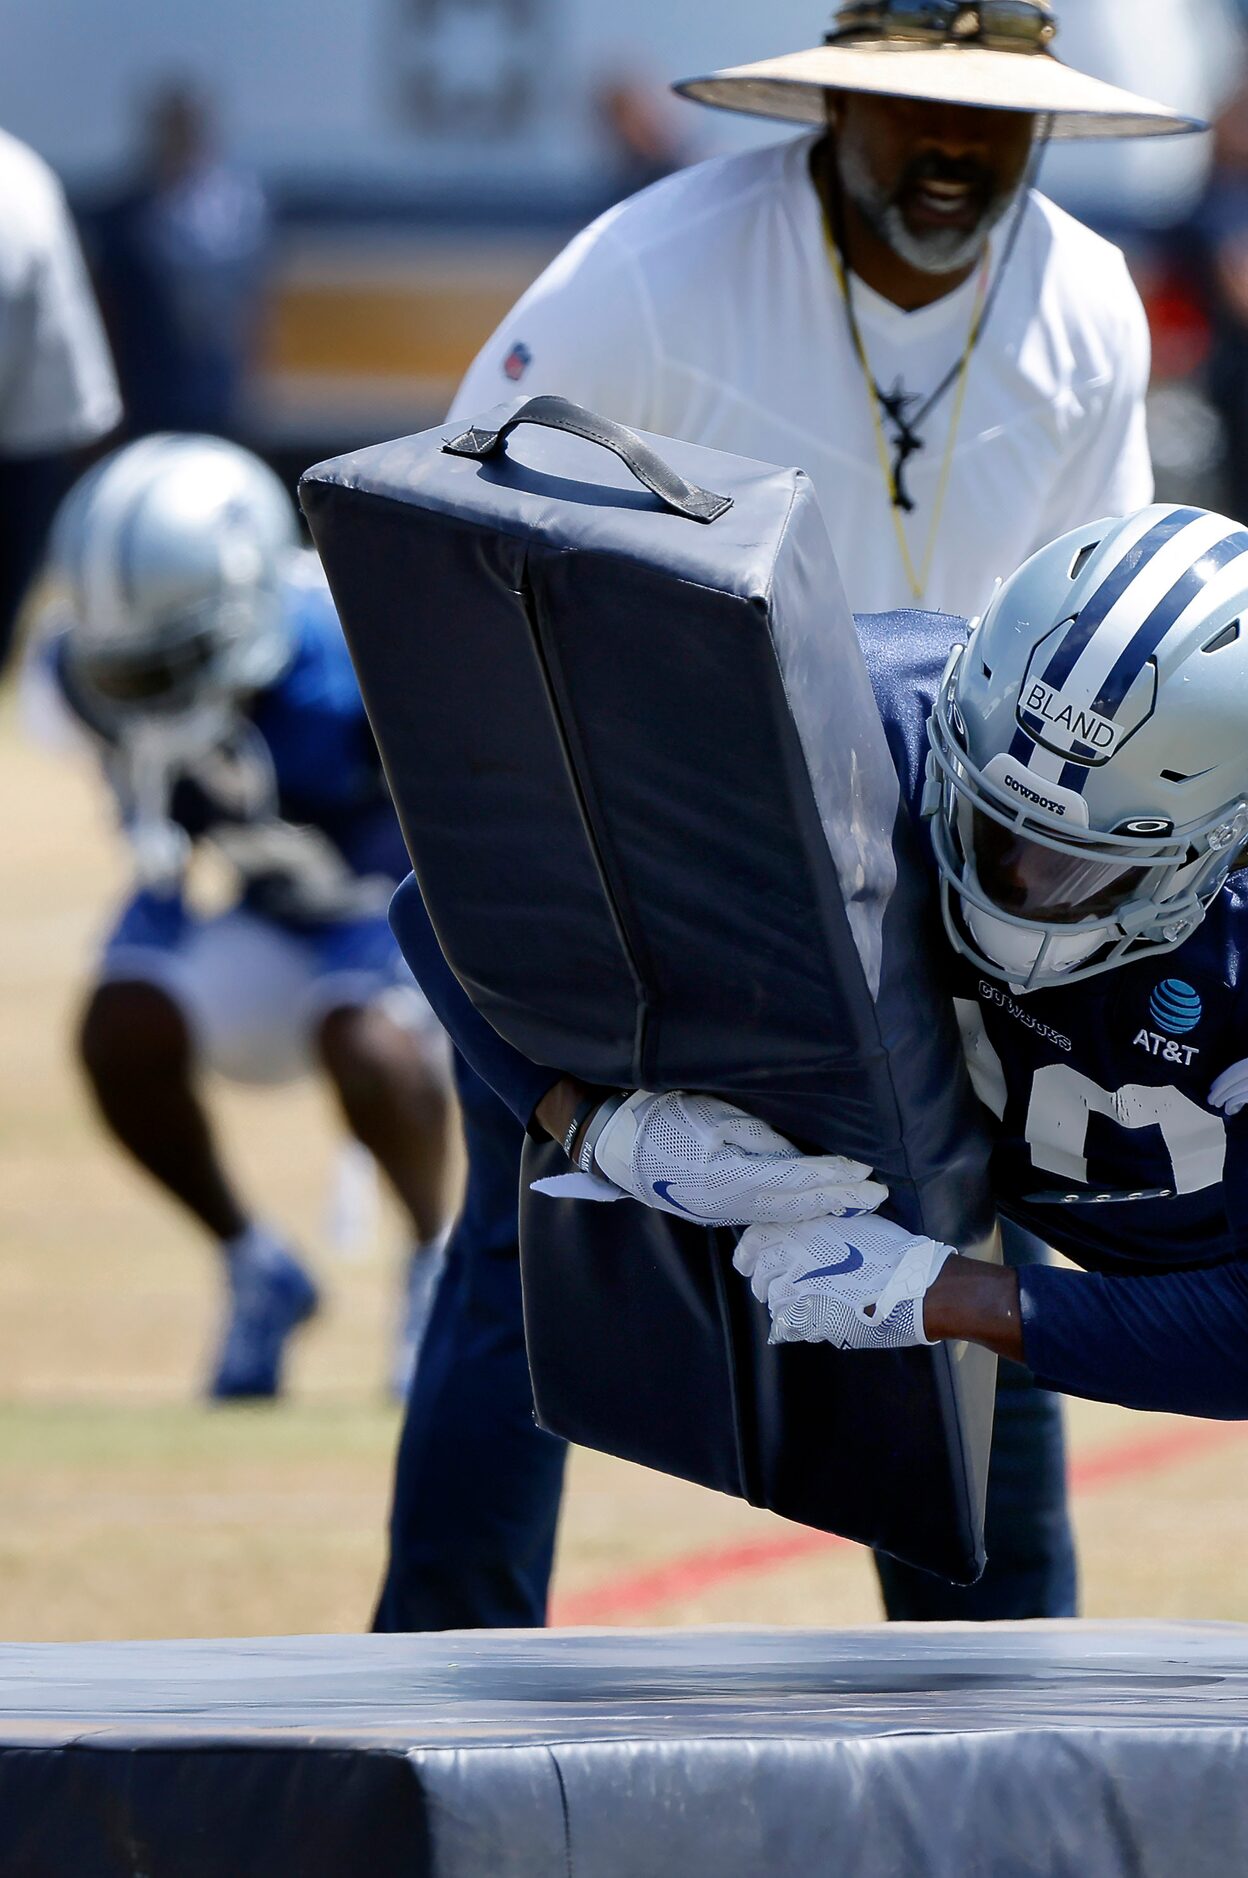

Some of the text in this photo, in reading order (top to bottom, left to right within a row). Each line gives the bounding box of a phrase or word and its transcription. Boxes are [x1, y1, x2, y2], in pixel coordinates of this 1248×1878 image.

[1026, 684, 1115, 748] BLAND
[1004, 774, 1066, 816] COWBOYS
[978, 980, 1072, 1052] COWBOYS
[1133, 1029, 1200, 1066] AT&T
